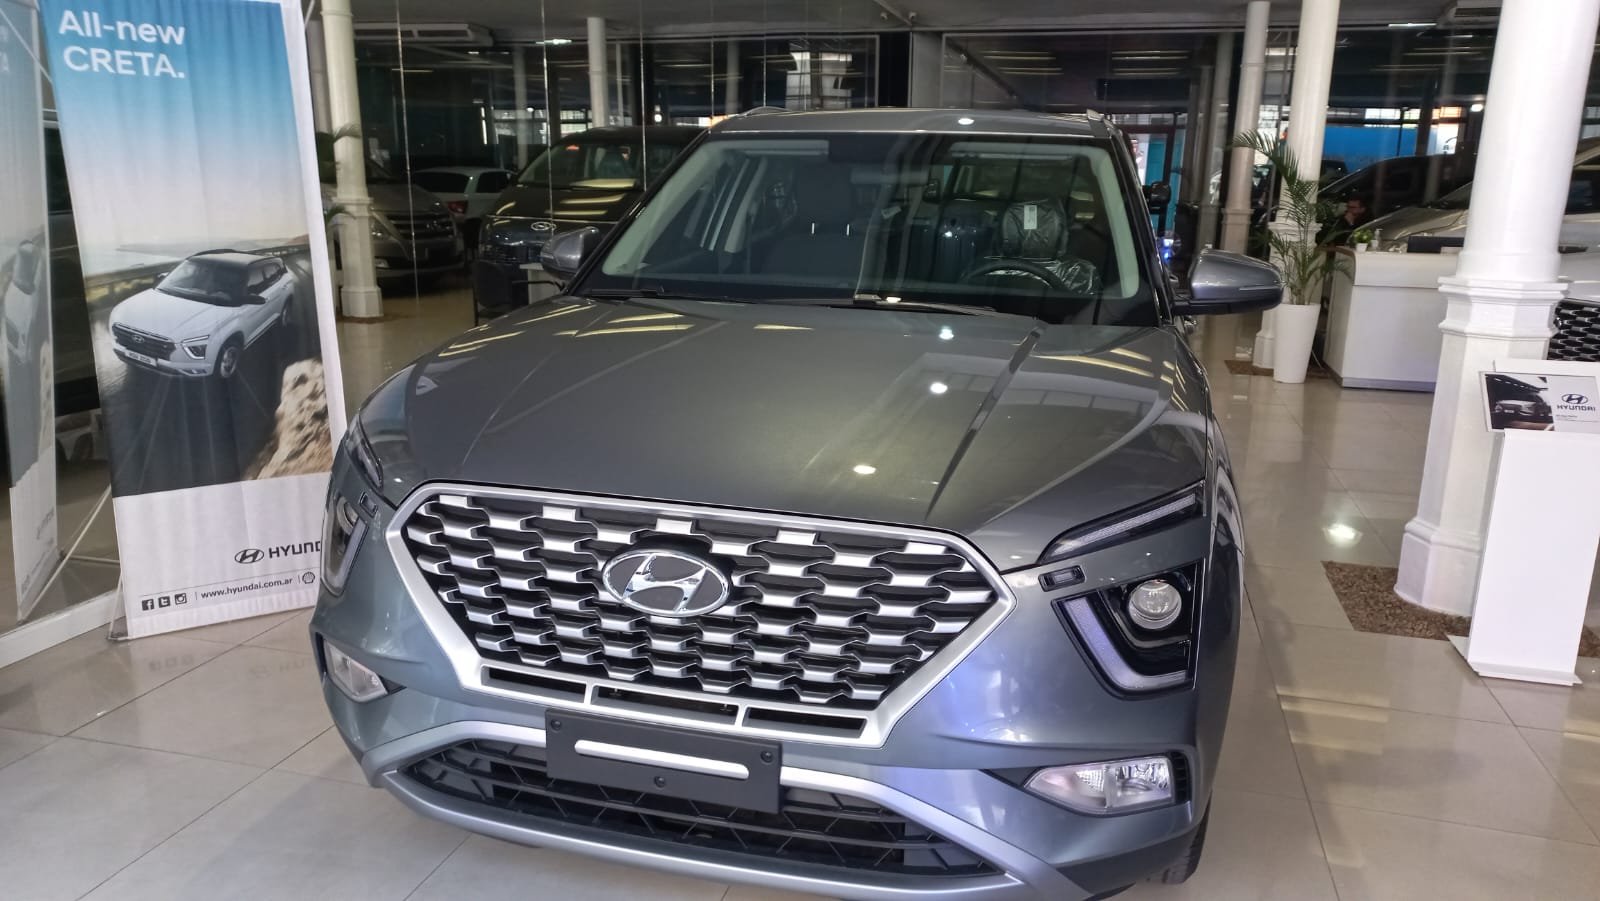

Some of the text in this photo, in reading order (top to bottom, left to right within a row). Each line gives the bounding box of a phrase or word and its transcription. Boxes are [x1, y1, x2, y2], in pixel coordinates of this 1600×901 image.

[59, 9, 186, 46] All-new
[63, 45, 185, 79] CRETA.
[1556, 404, 1596, 412] HYUNDAI
[200, 578, 294, 599] www.hyundai.com.ar
